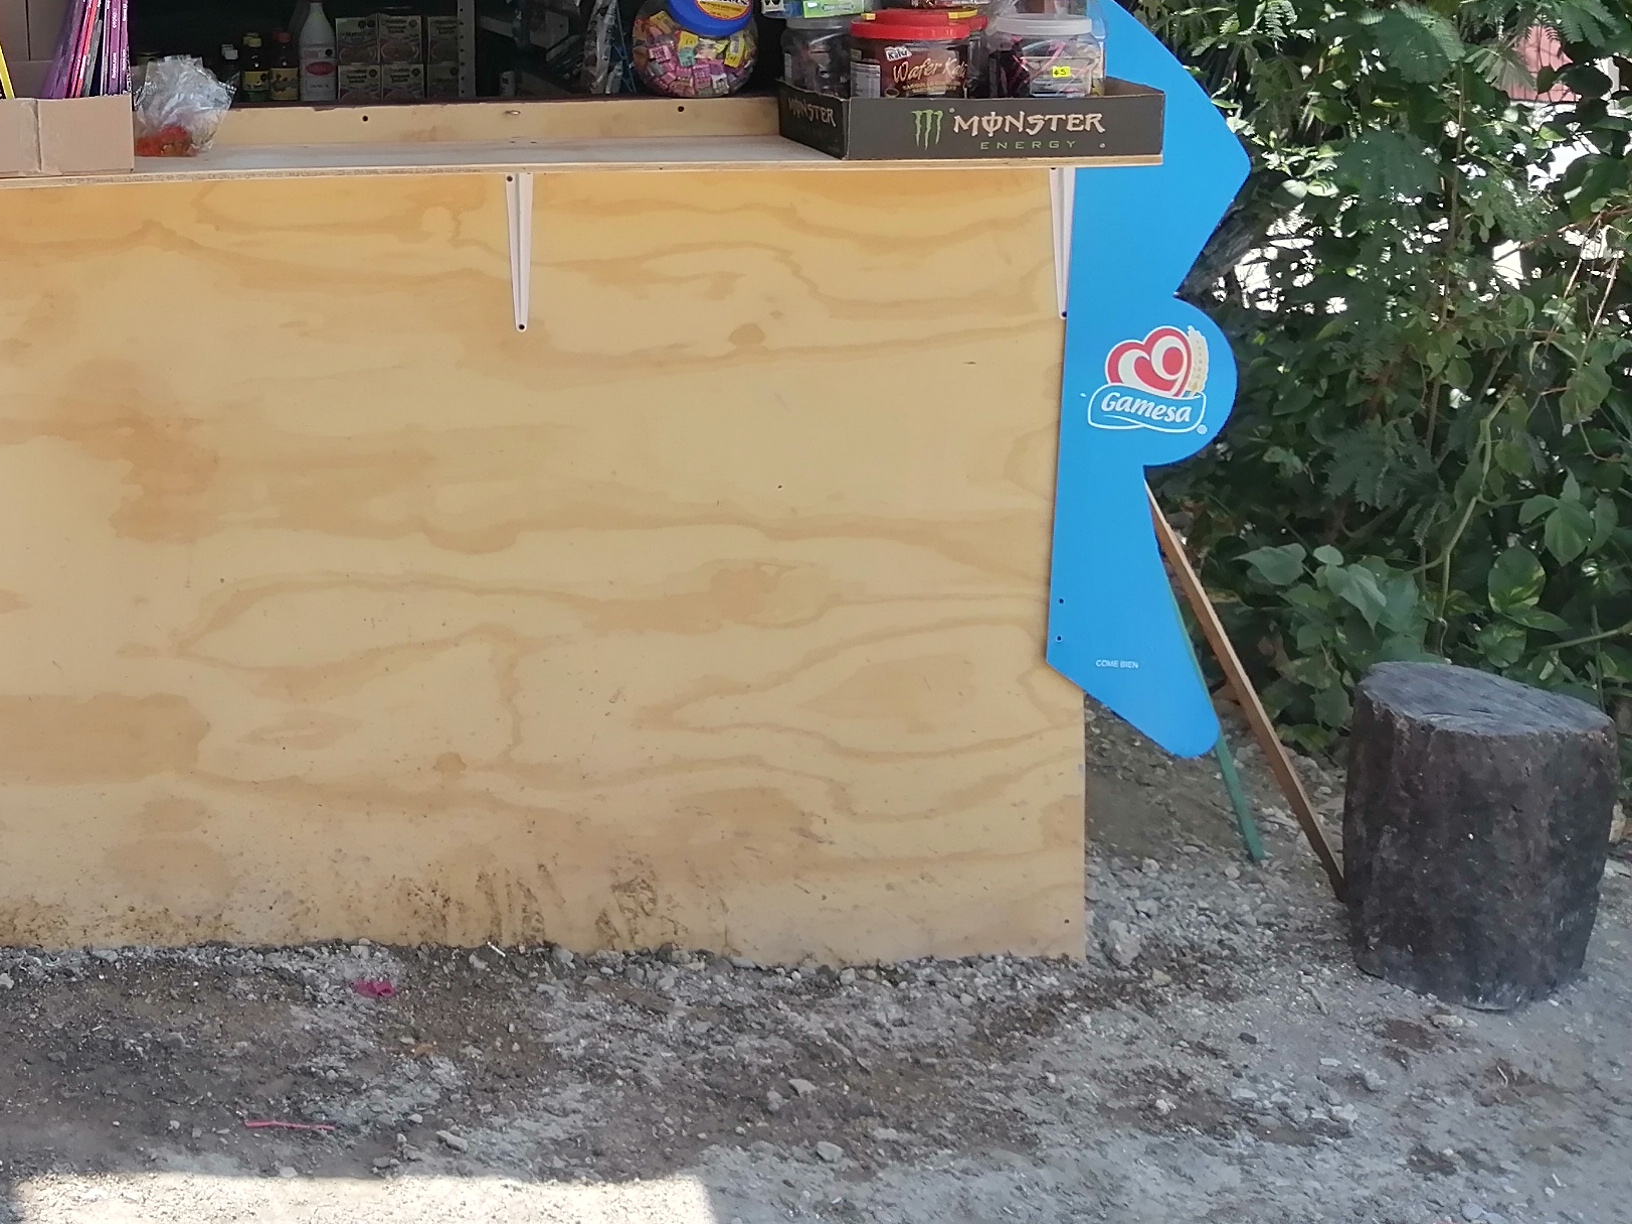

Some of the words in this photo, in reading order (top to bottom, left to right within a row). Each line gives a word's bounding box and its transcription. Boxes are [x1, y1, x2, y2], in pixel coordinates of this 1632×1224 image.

[893, 59, 942, 84] Wafer
[953, 110, 1106, 137] MONSTER
[980, 140, 1077, 151] ENERGY
[1101, 392, 1191, 423] Gamesa
[1096, 660, 1119, 668] COME
[1120, 660, 1139, 669] BIEN
